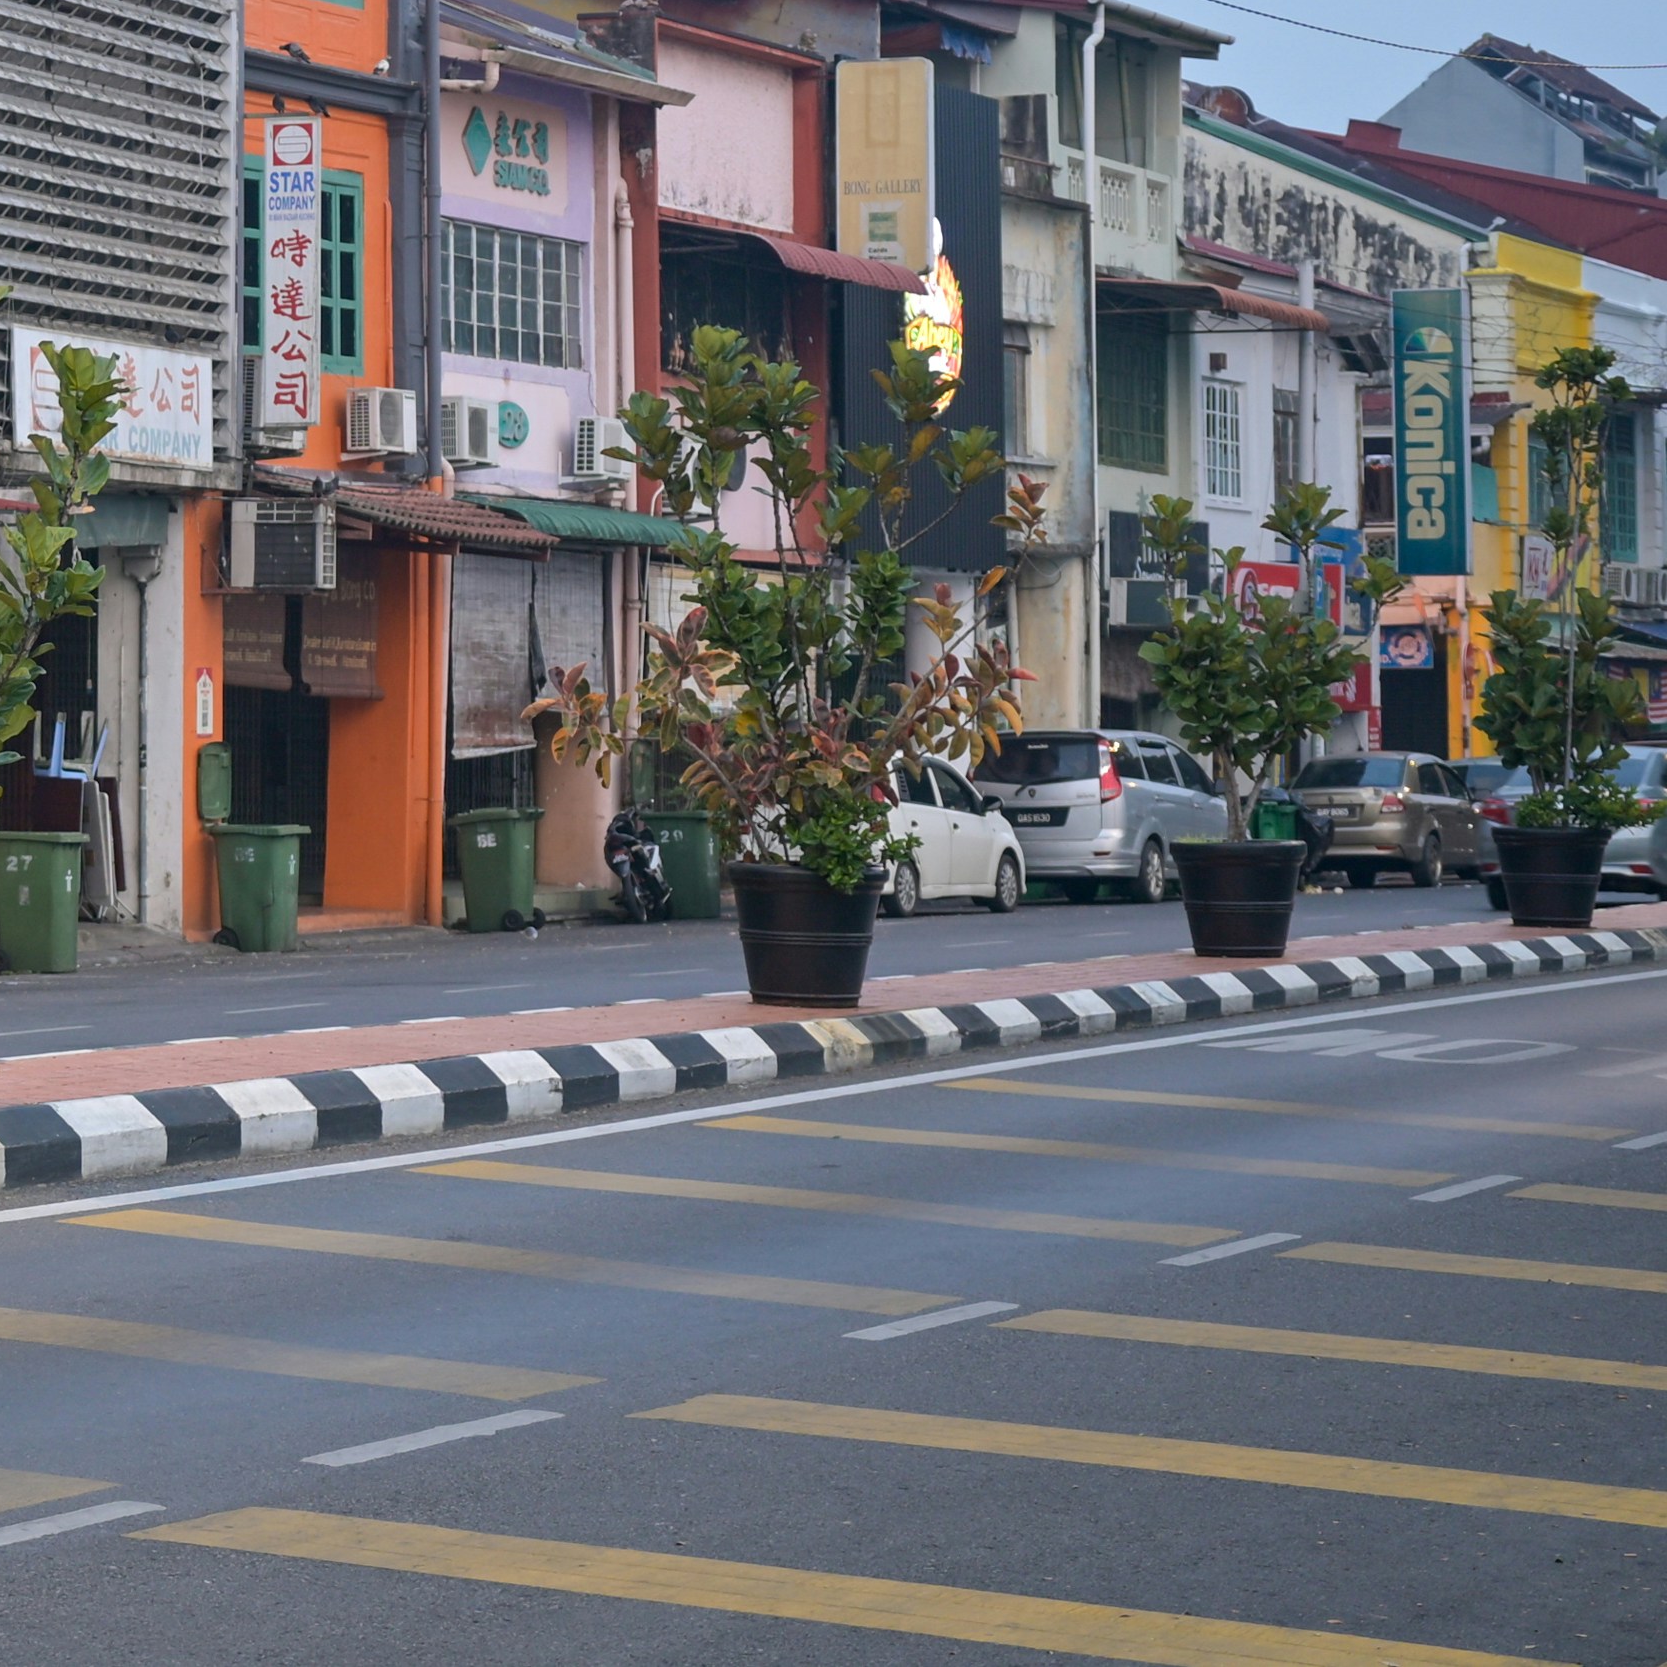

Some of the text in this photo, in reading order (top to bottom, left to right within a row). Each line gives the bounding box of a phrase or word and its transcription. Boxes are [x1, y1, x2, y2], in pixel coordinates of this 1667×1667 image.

[269, 171, 315, 193] STAR
[844, 178, 924, 195] BONG GALLERY
[268, 195, 316, 211] COMPANY
[128, 425, 201, 459] COMPANY
[1403, 359, 1456, 540] Konica
[6, 855, 33, 871] 27
